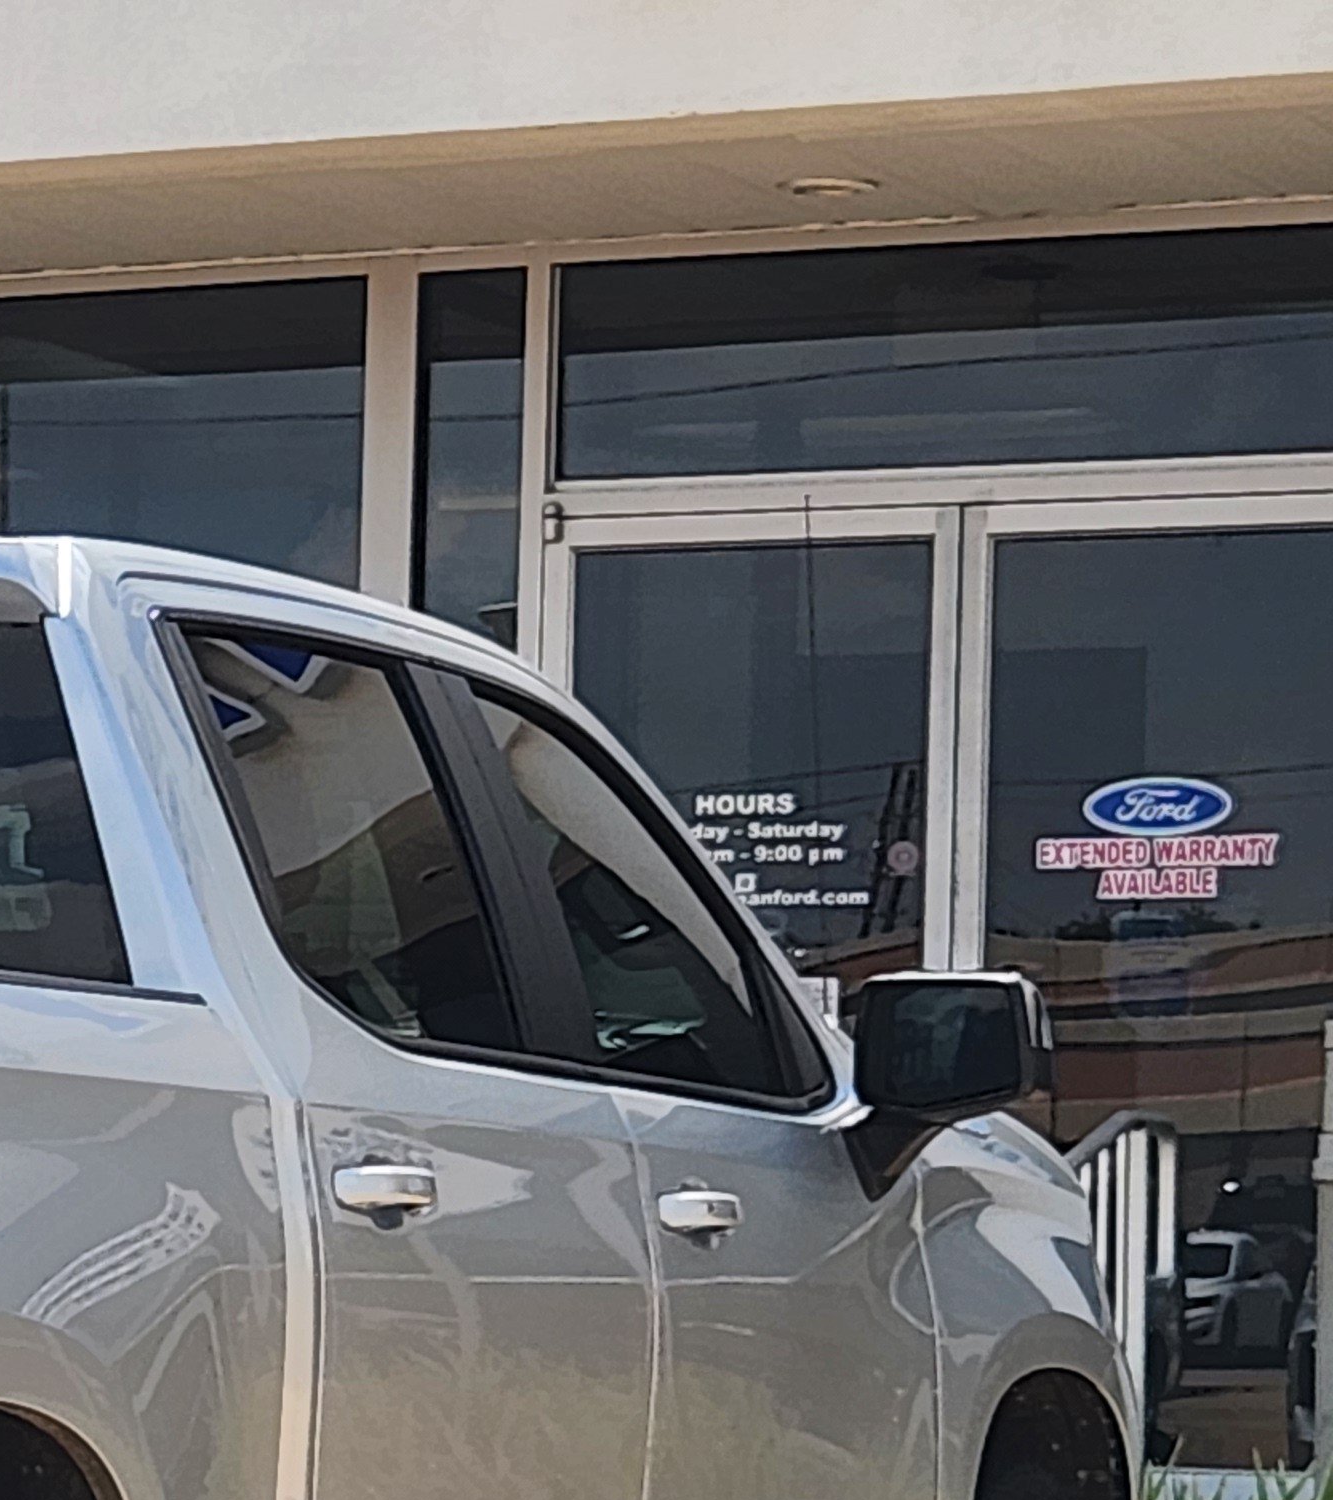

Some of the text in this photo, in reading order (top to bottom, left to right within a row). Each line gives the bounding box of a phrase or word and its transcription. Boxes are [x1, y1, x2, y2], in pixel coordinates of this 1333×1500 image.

[694, 793, 797, 815] HOURS
[1114, 787, 1206, 822] Ford
[690, 822, 731, 844] day
[747, 821, 846, 842] Saturday
[753, 844, 803, 863] 9:00
[1038, 836, 1277, 866] EXTENDED WARRANTY
[1100, 869, 1216, 895] AVAILABLE
[737, 889, 870, 906] anford.com
